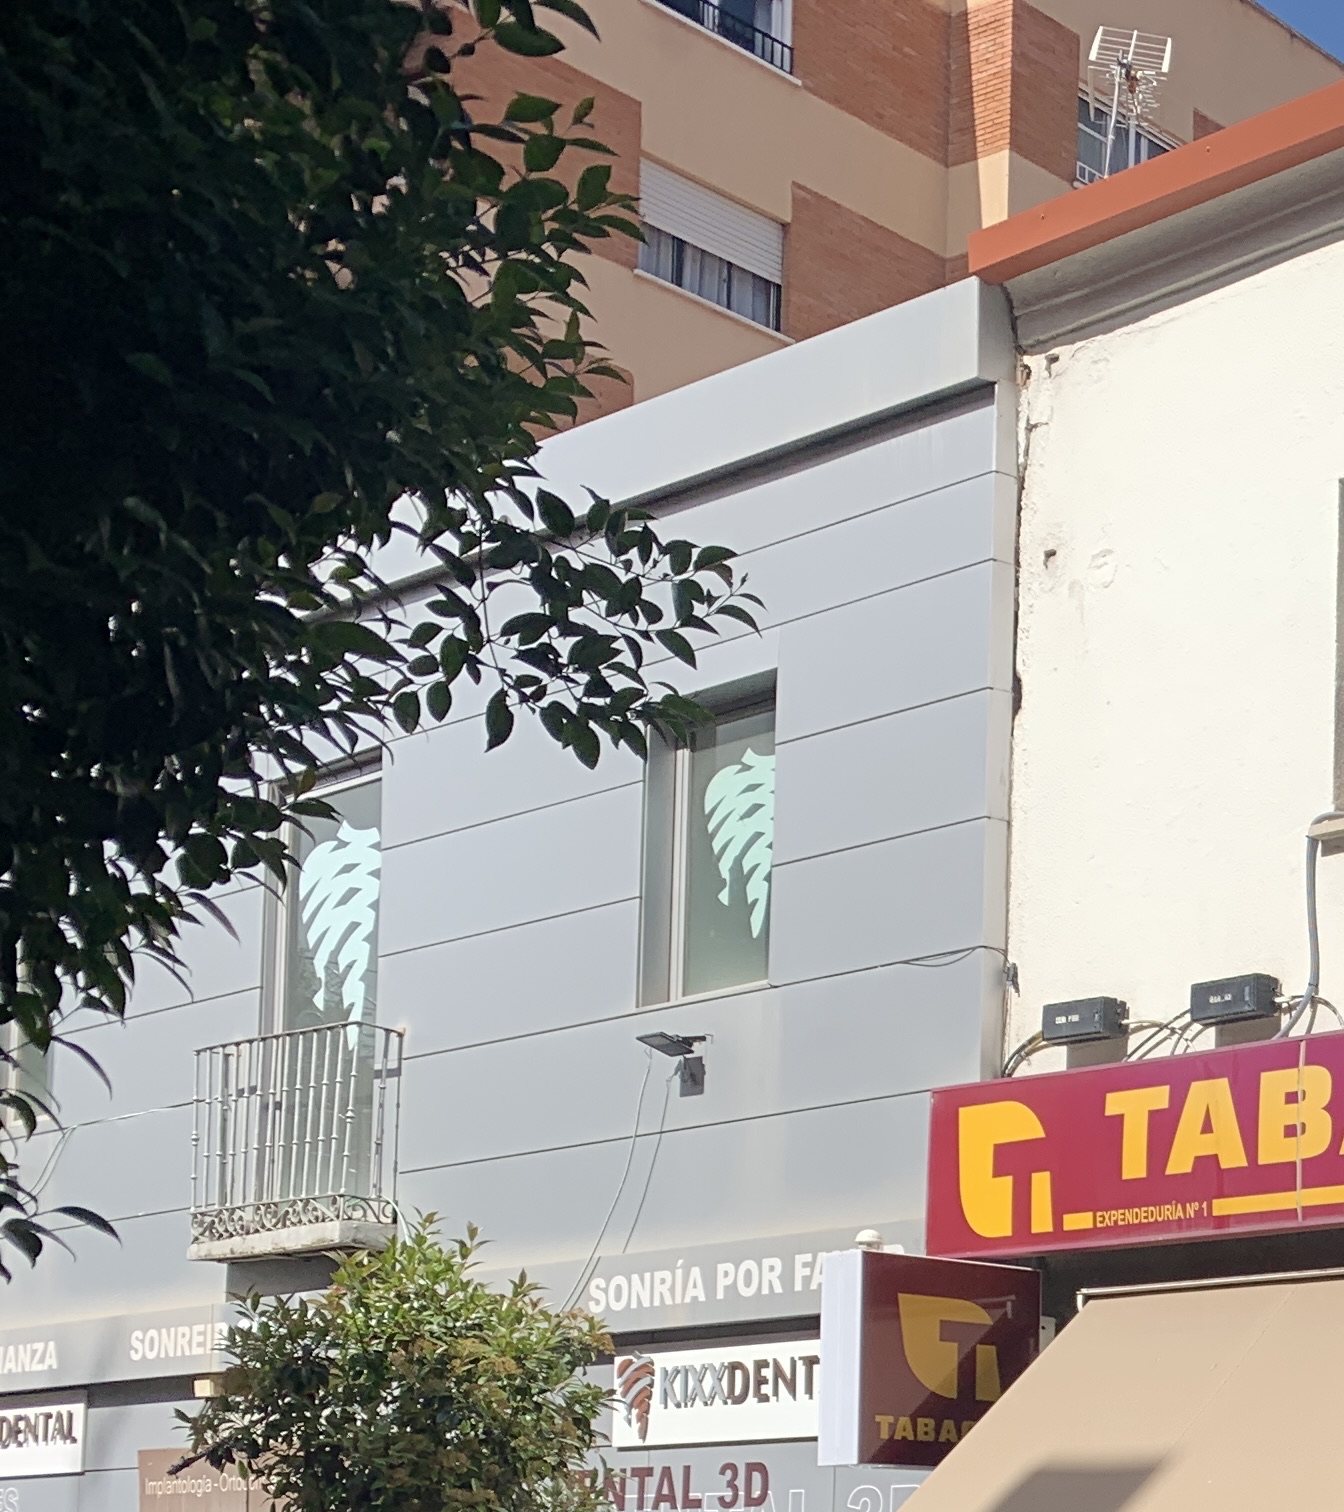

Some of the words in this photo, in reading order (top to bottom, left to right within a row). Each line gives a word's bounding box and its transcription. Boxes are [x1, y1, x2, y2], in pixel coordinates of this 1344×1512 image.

[1096, 1201, 1184, 1228] EXPENDEDURÍA
[1202, 1201, 1208, 1217] 1
[588, 1259, 706, 1314] SONRÍA
[716, 1257, 783, 1300] POR
[660, 1354, 820, 1409] KIXXDENT
[875, 1414, 977, 1442] TABA
[717, 1461, 770, 1509] 3D
